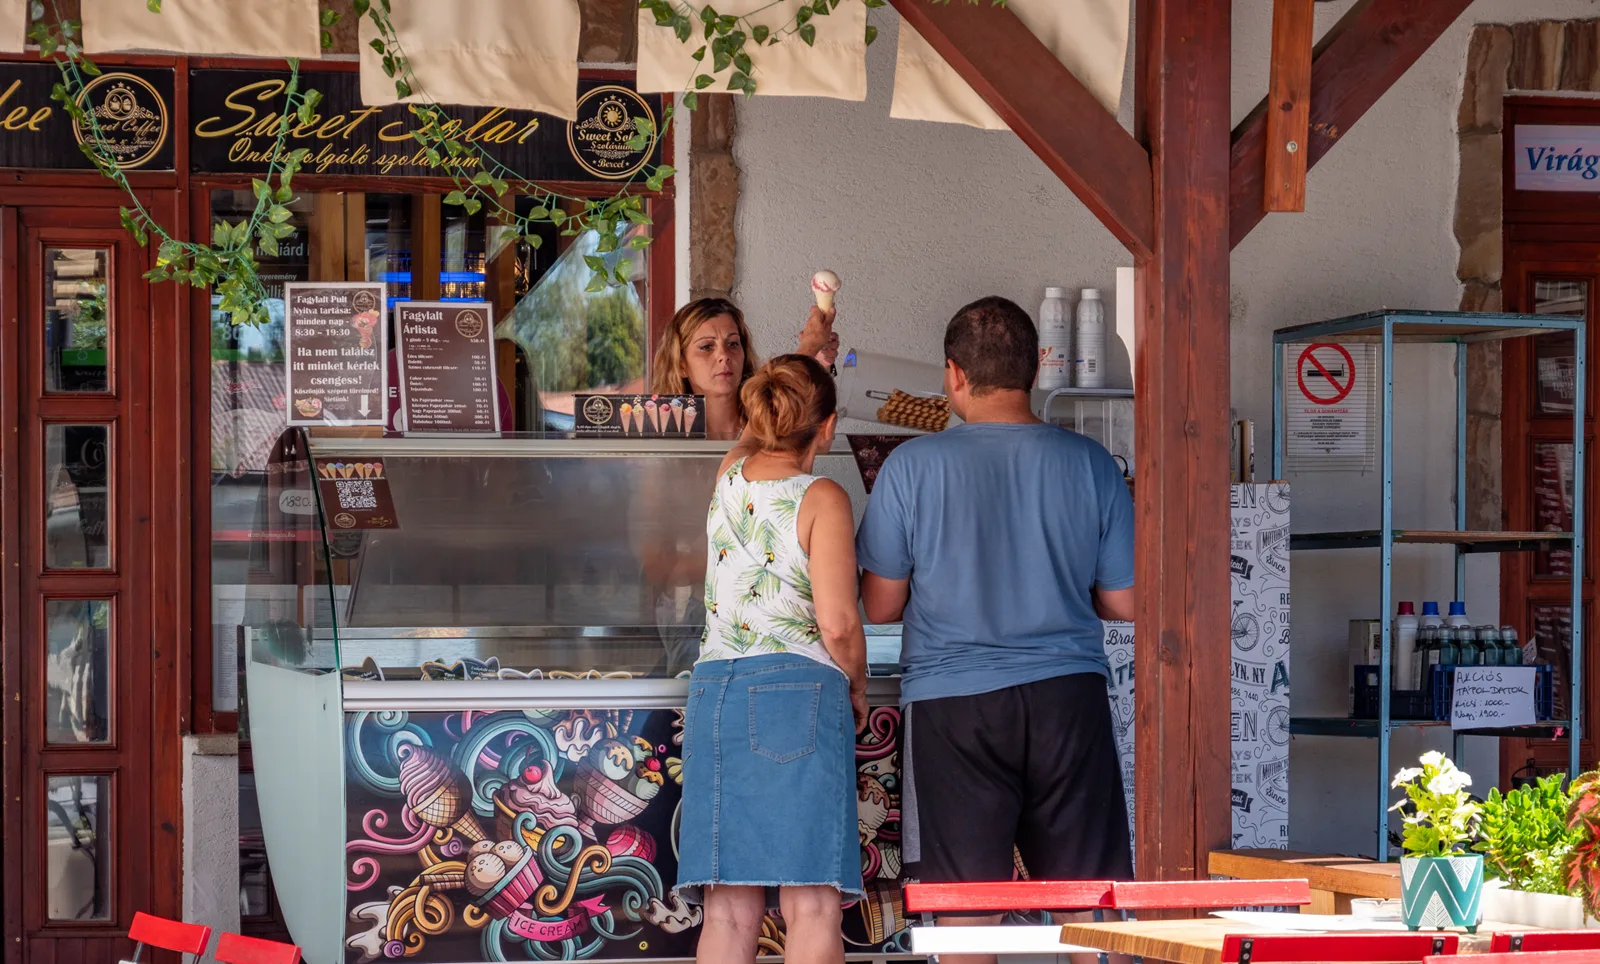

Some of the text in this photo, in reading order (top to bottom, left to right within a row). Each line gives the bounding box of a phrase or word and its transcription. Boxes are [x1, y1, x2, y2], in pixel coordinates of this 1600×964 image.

[196, 79, 382, 139] Sweet
[121, 117, 161, 136] Coffee
[578, 129, 636, 143] Sweet Sol
[228, 131, 481, 174] Önkisolgáló szoláium
[1525, 146, 1600, 180] Virág
[297, 295, 329, 305] Fagylalt
[293, 307, 352, 316] Nyitva tartása:
[403, 310, 443, 322] Fagylalt
[296, 318, 326, 326] minden
[295, 328, 315, 337] 8:30
[326, 328, 350, 337] 19:30
[403, 323, 437, 335] Árlista
[297, 346, 375, 357] Ha nem találsz
[293, 360, 380, 371] itt minket kérlek
[310, 376, 362, 387] csengess!
[1265, 554, 1287, 574] Since
[1252, 667, 1266, 685] NY
[1244, 689, 1259, 702] 7440
[1265, 787, 1288, 806] Since
[514, 917, 583, 937] ICE CREAM
